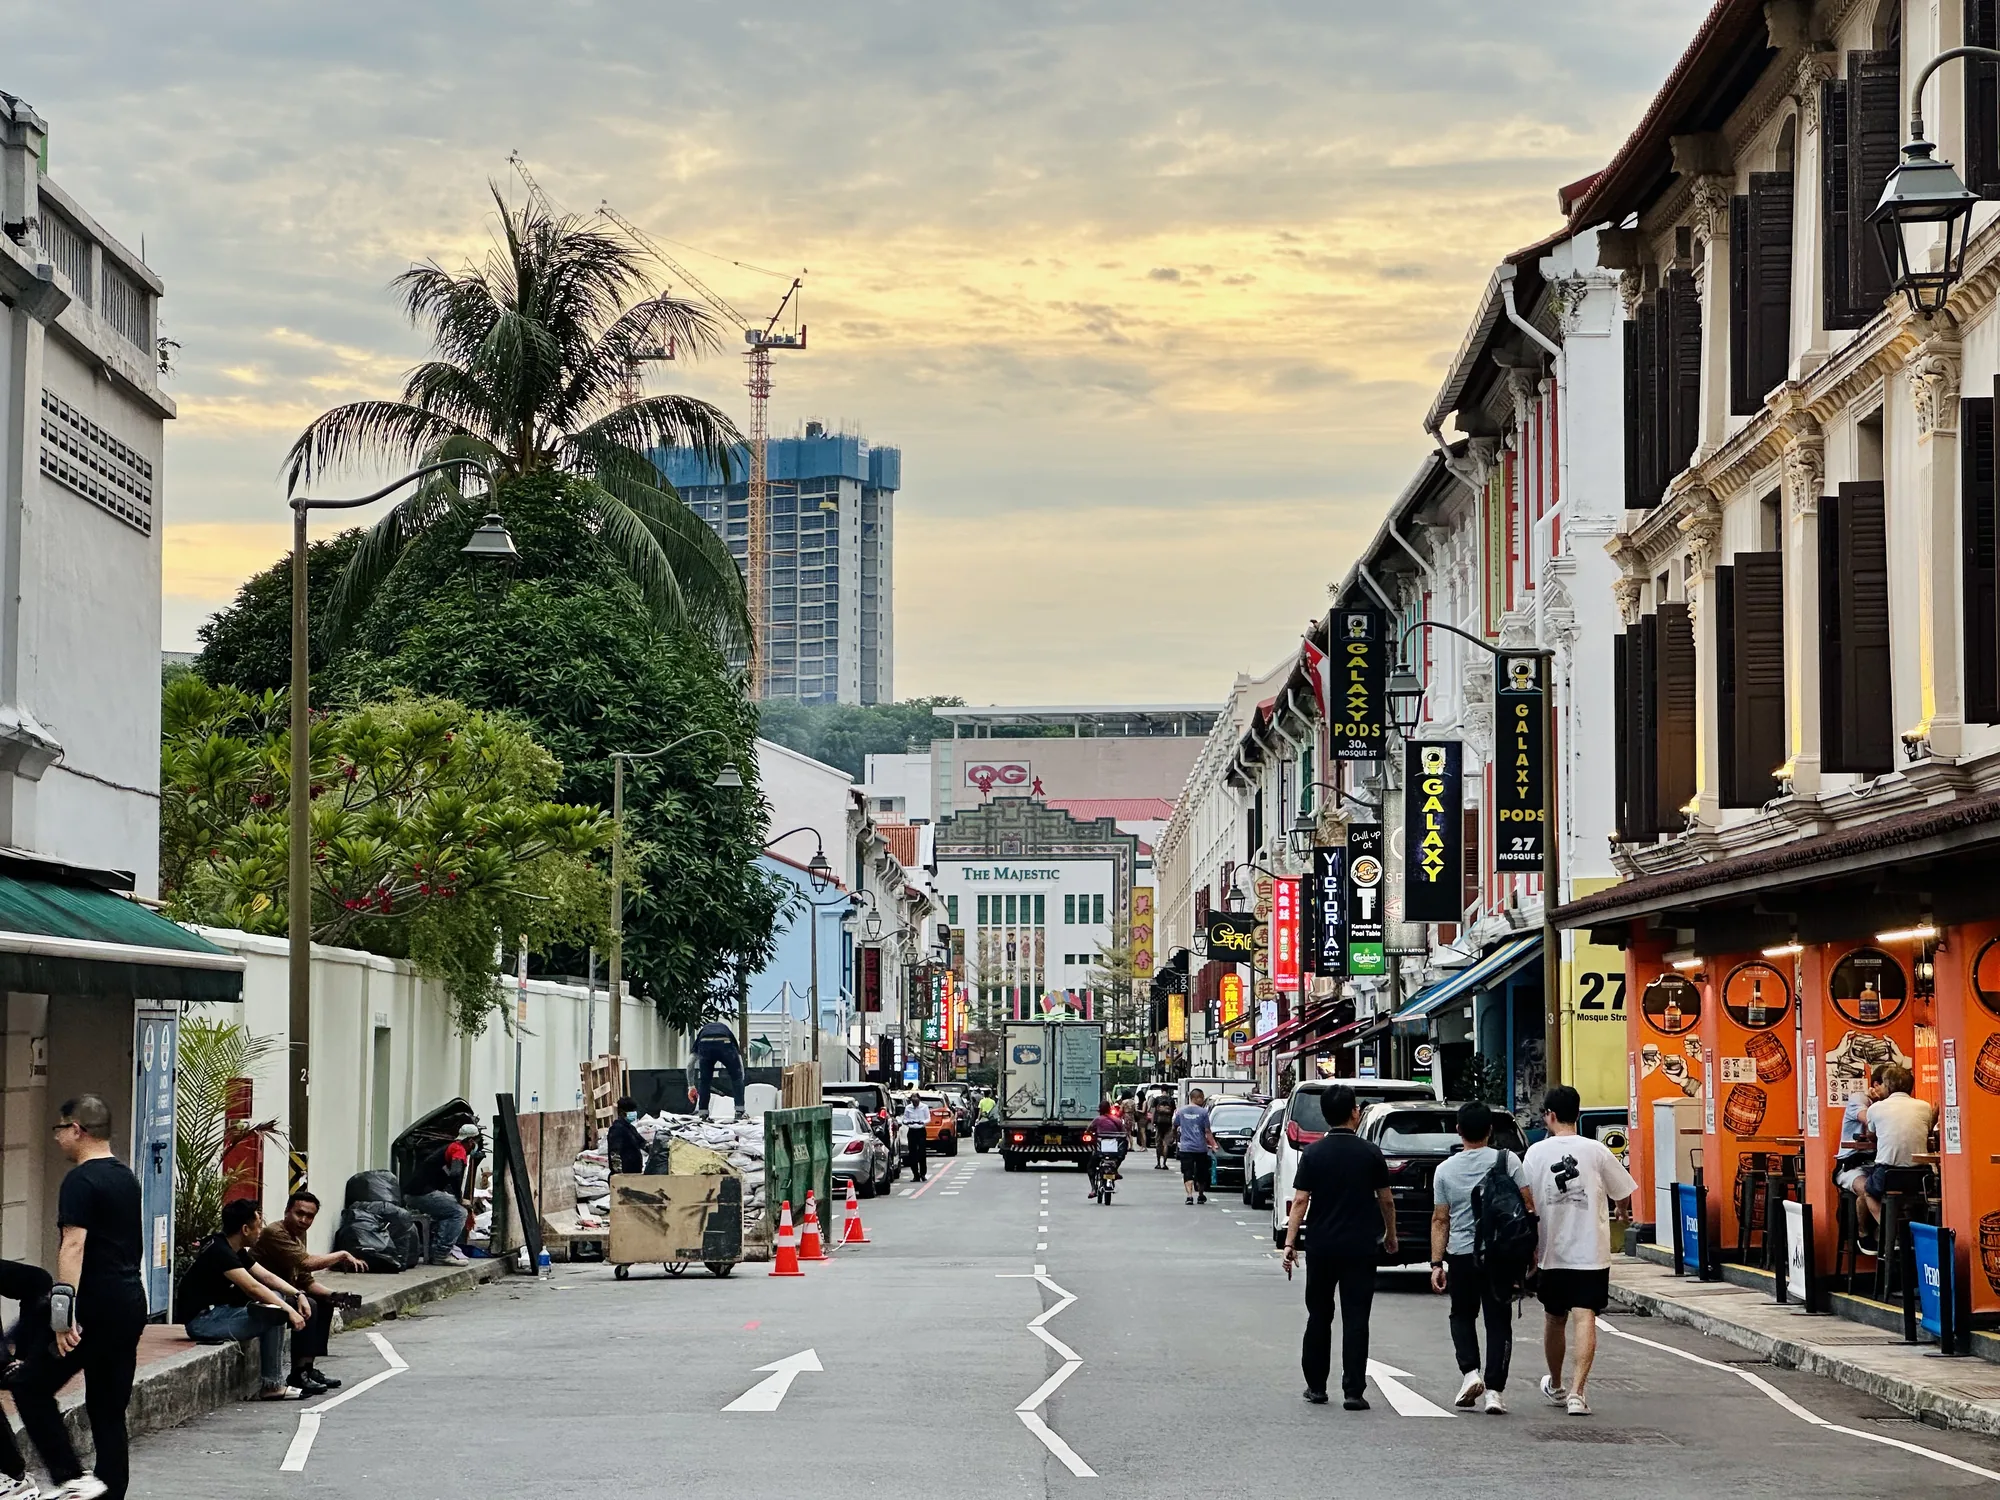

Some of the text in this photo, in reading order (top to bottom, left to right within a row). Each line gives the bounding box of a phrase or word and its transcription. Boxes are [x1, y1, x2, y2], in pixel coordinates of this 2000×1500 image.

[1346, 643, 1369, 721] GALAXY
[1334, 724, 1380, 737] PODS
[1348, 740, 1367, 749] 30A
[1516, 704, 1529, 799] GALAXY
[968, 765, 1027, 784] OG
[1500, 809, 1544, 822] PODS
[1371, 831, 1381, 840] up
[1421, 778, 1444, 882] GALAXY
[1362, 841, 1372, 850] at
[1511, 838, 1536, 850] 27
[962, 868, 1060, 882] THE MAJESTIC
[1323, 853, 1338, 948] VICTORIA
[1580, 972, 1626, 1010] 27
[1576, 1014, 1608, 1022] Mosque
